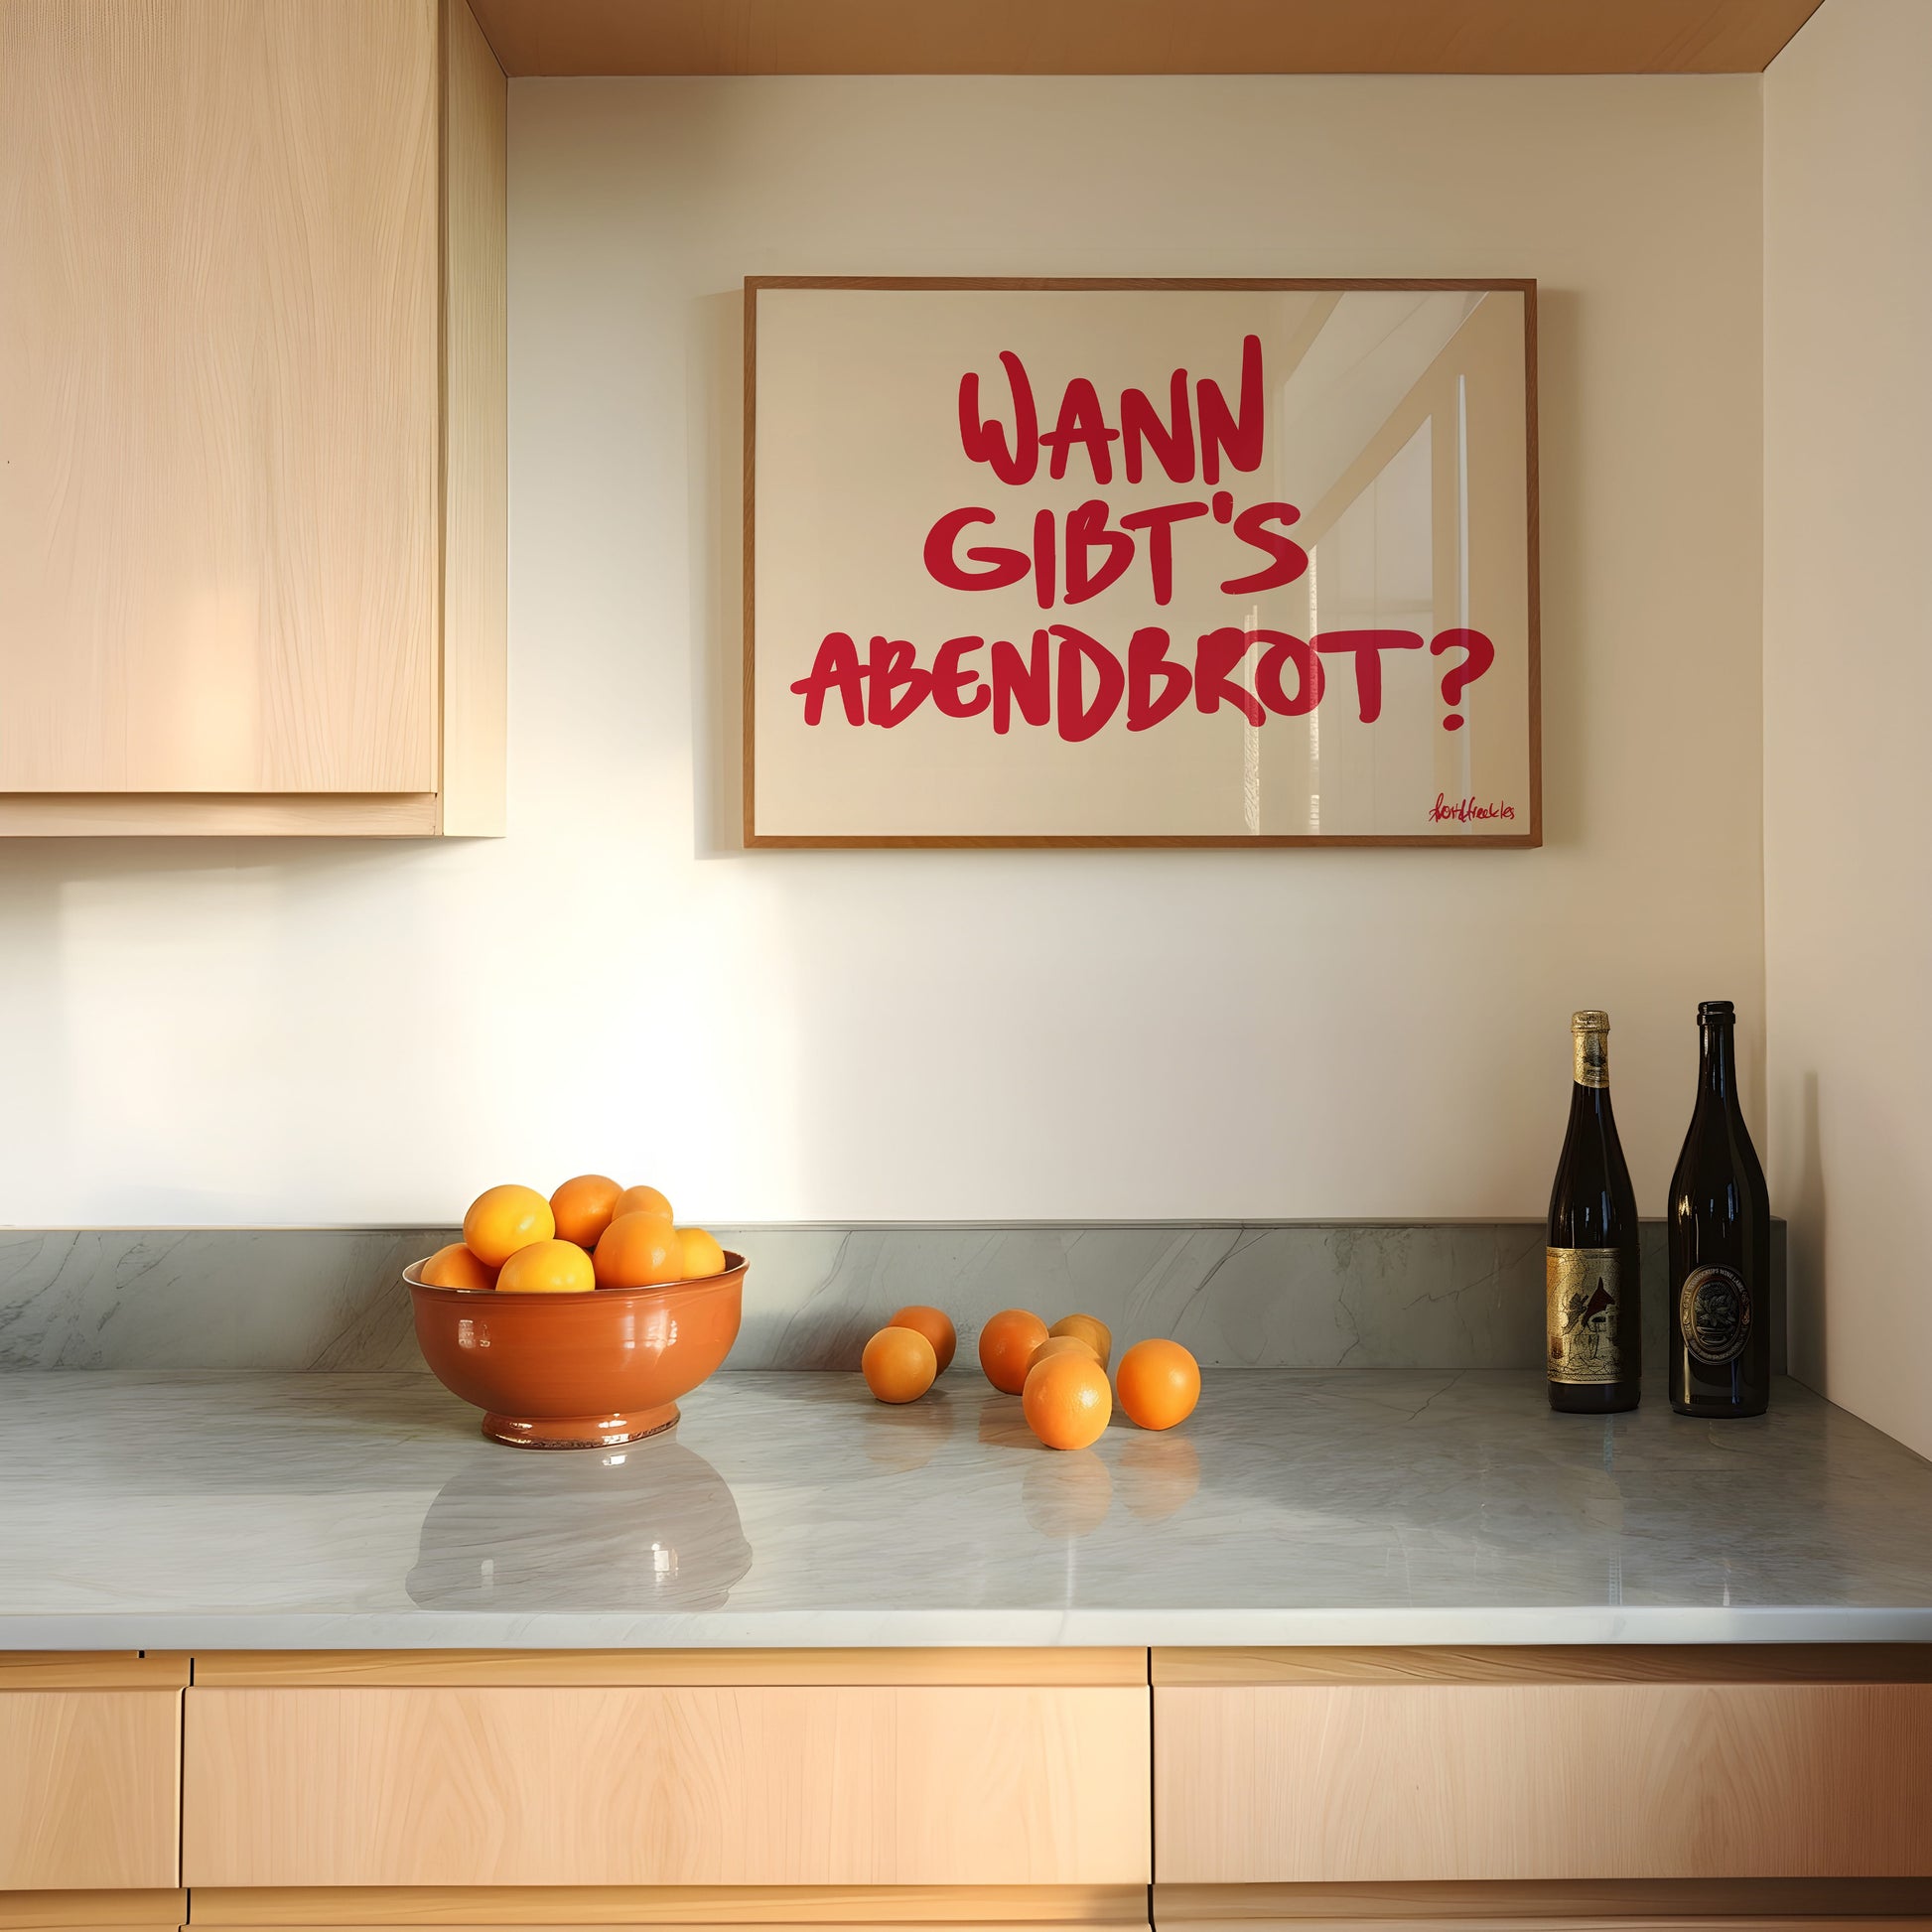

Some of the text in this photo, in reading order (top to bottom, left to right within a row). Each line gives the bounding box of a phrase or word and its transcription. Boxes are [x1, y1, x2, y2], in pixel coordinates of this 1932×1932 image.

[958, 335, 1264, 485] WANN
[923, 490, 1309, 610] GIBT'S
[789, 623, 1495, 743] ABENDBROT?
